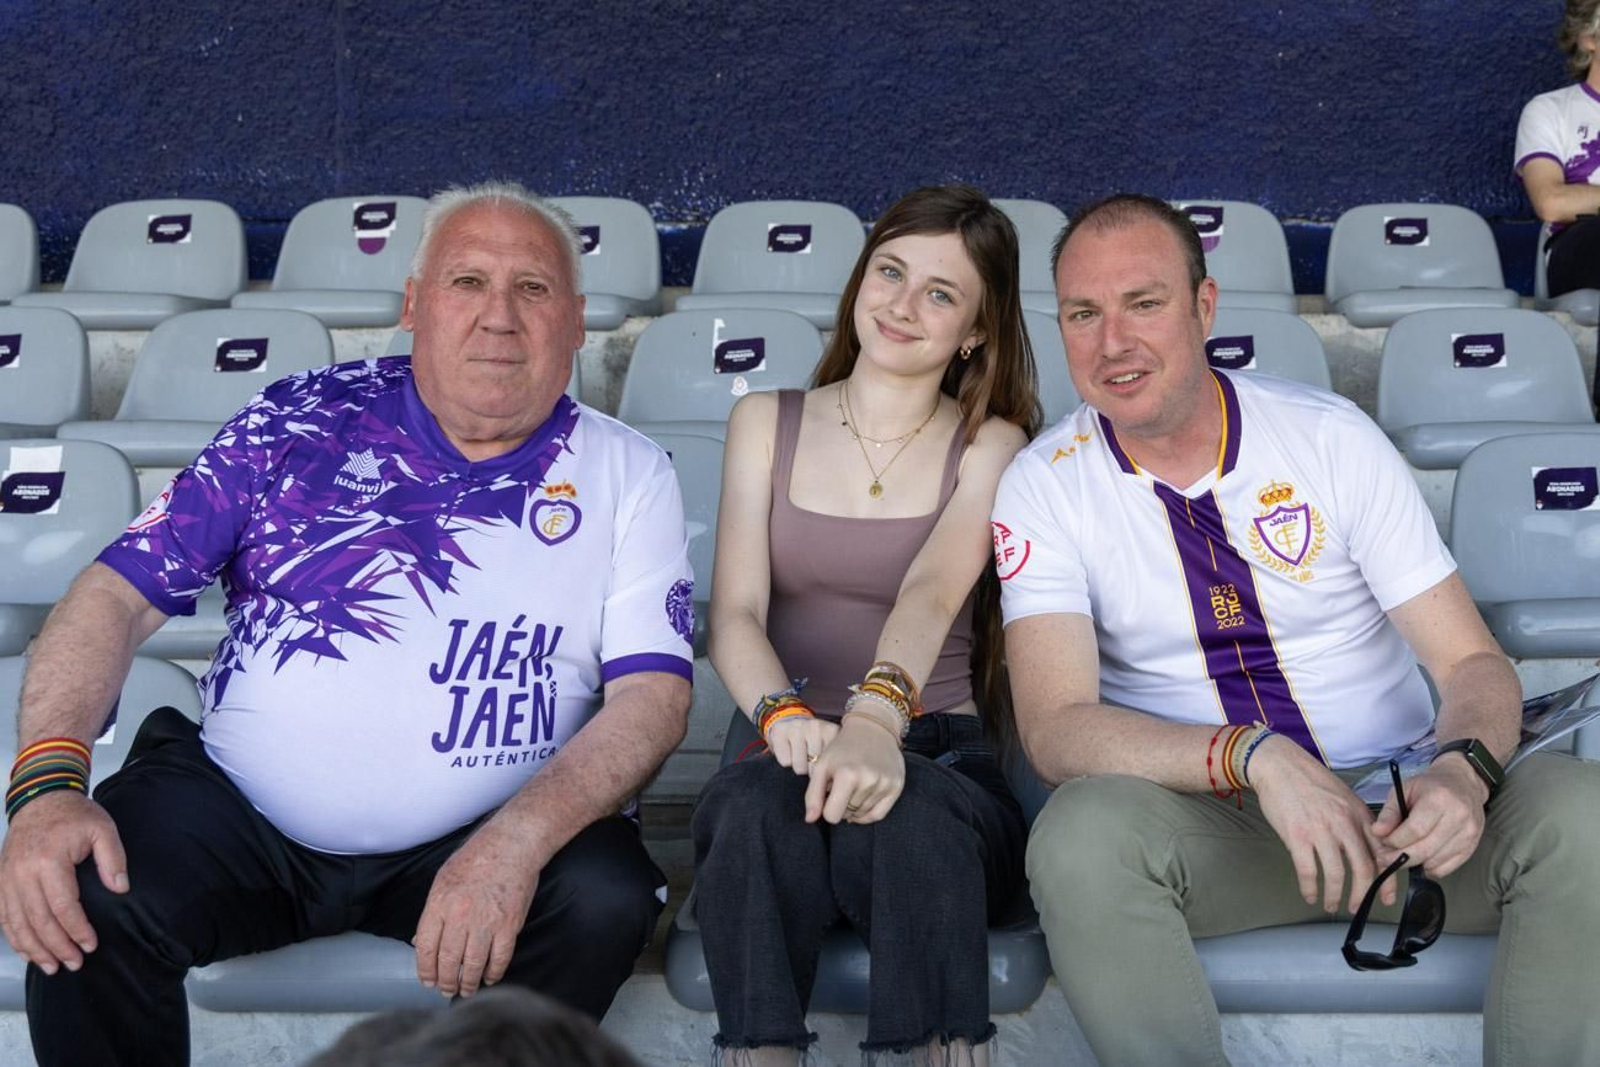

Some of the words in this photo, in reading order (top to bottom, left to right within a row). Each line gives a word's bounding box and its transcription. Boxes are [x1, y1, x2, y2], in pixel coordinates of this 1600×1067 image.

[12, 488, 50, 496] ABONADOS
[1209, 583, 1236, 596] 1922
[1211, 592, 1239, 608] RJ
[1214, 603, 1242, 619] CF
[1217, 615, 1246, 630] 2022
[450, 746, 557, 768] AUTÉNTICA
